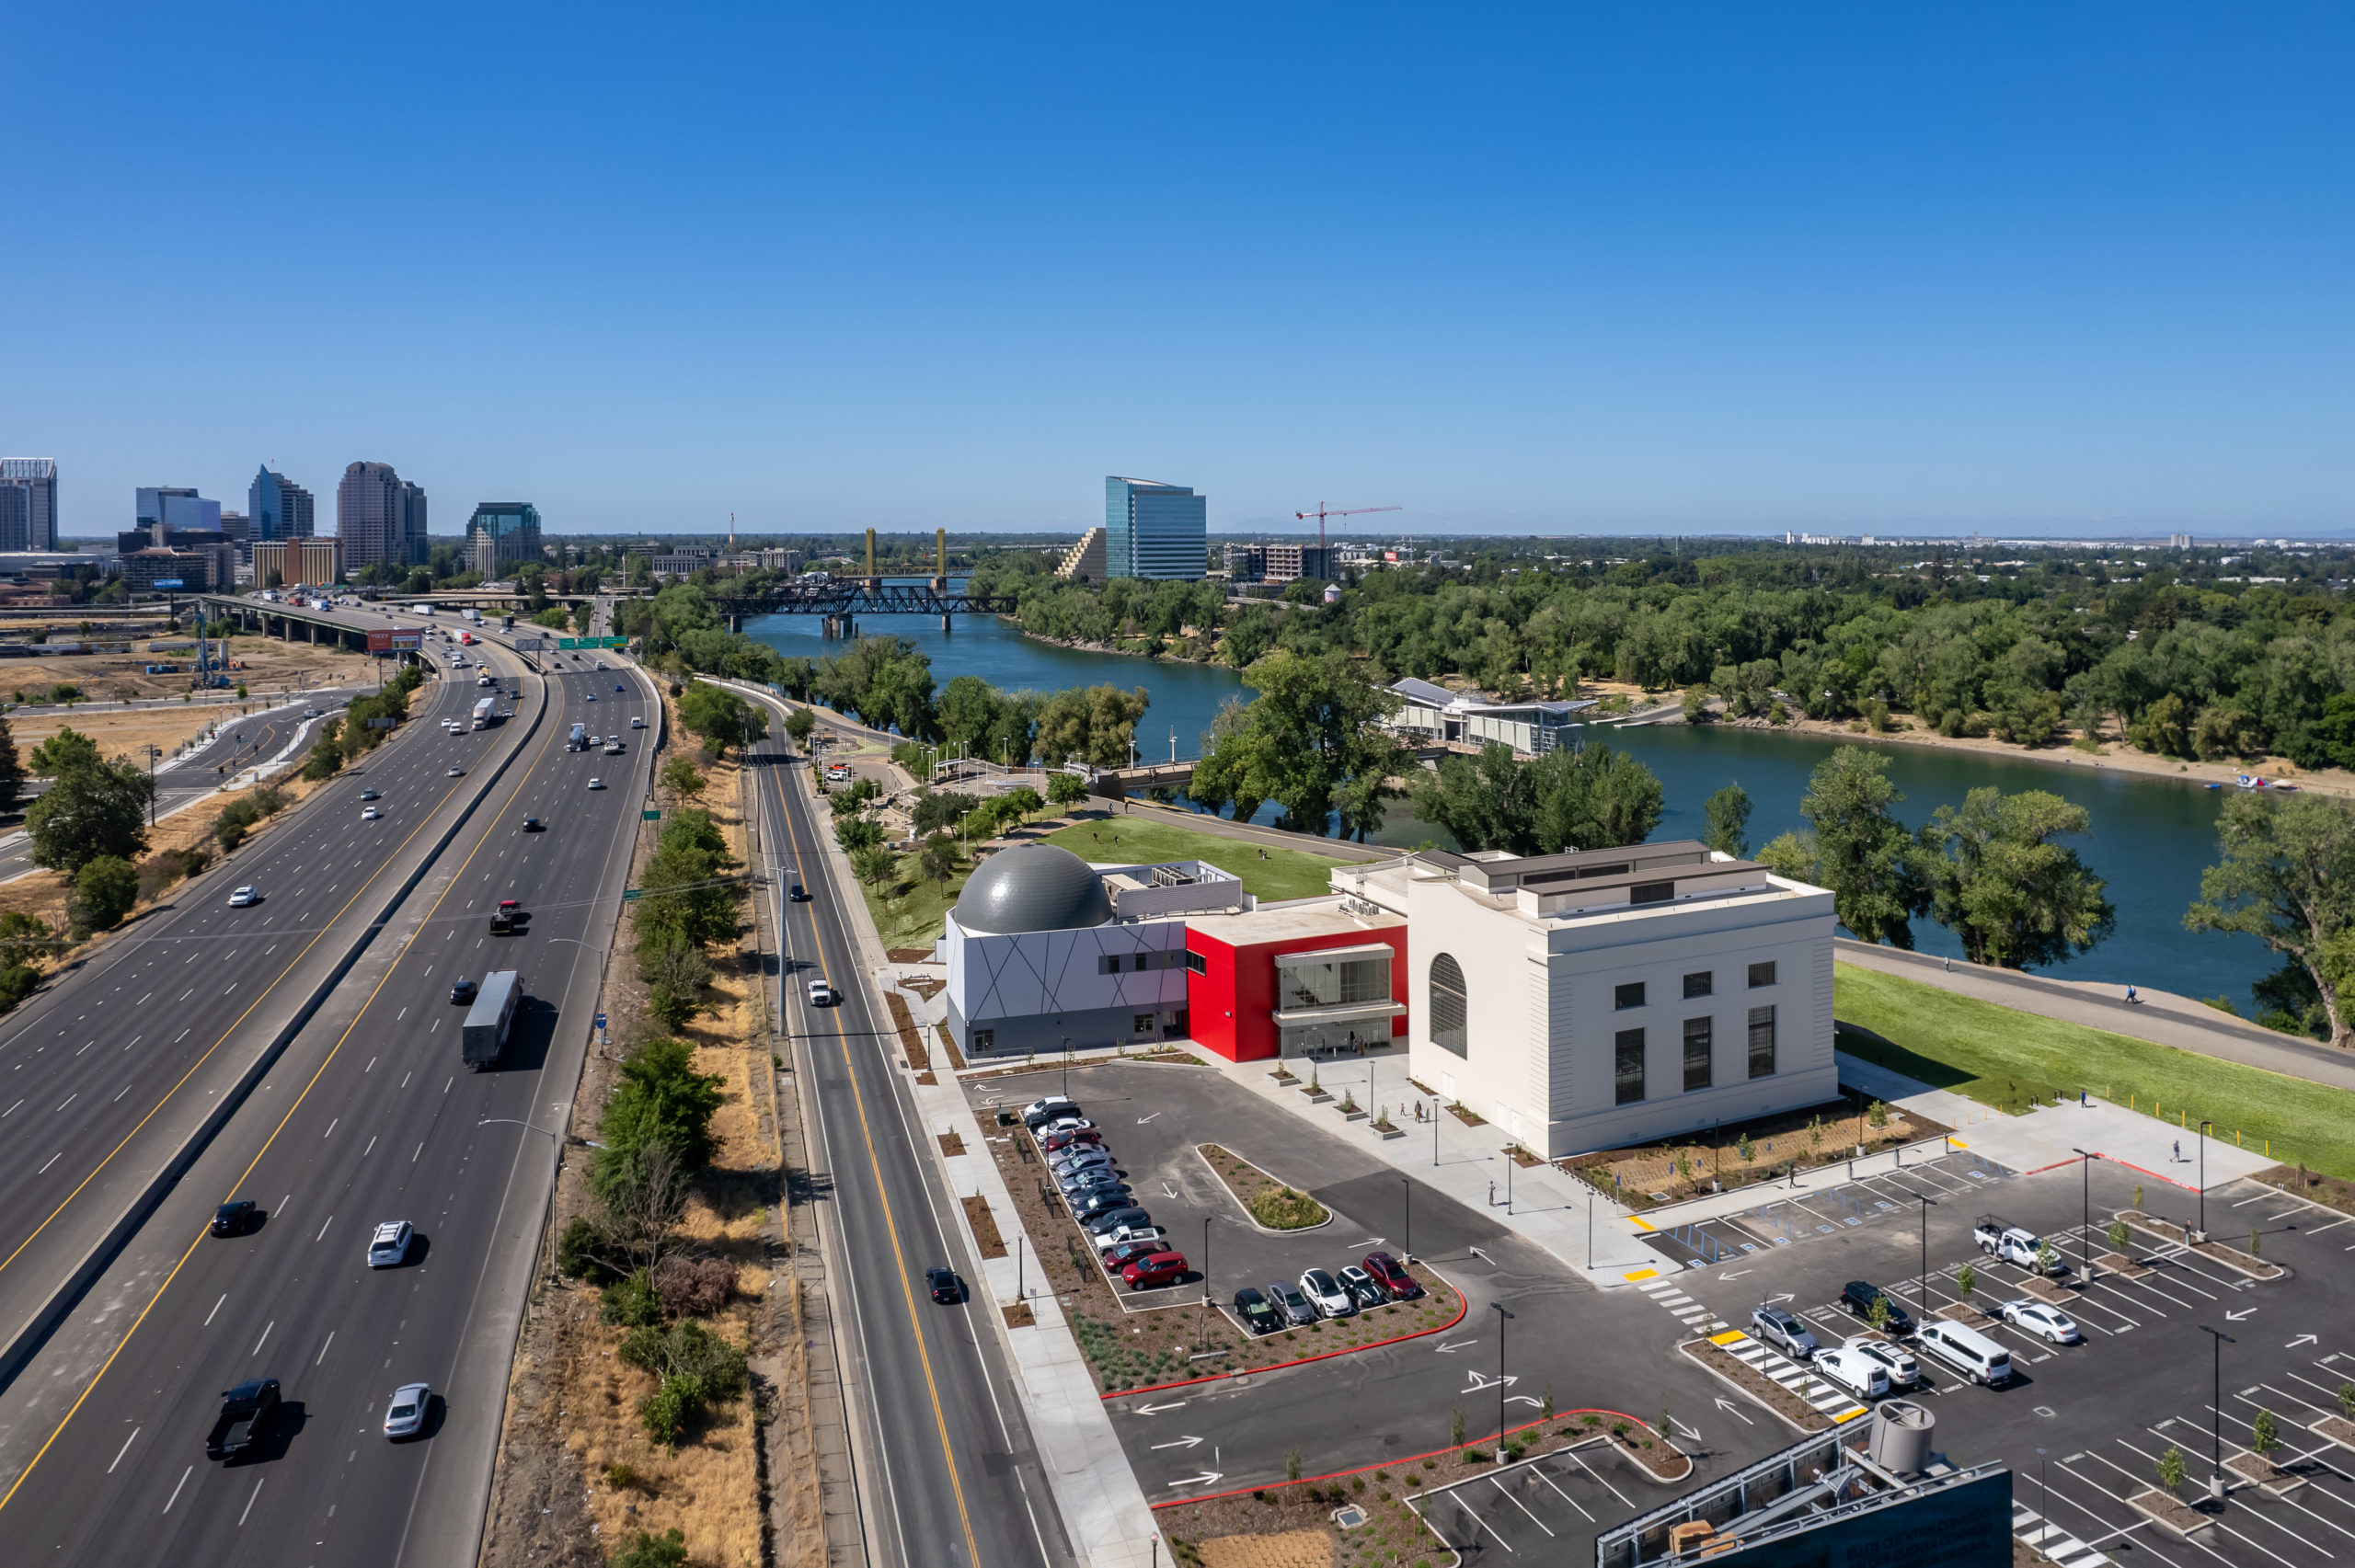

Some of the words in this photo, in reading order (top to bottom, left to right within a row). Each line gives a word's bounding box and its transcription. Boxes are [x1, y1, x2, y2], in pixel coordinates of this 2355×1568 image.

[1846, 1540, 1879, 1561] ELLOS
[1882, 1523, 1936, 1549] CUENTAN
[1893, 1538, 1938, 1562] CUENTA
